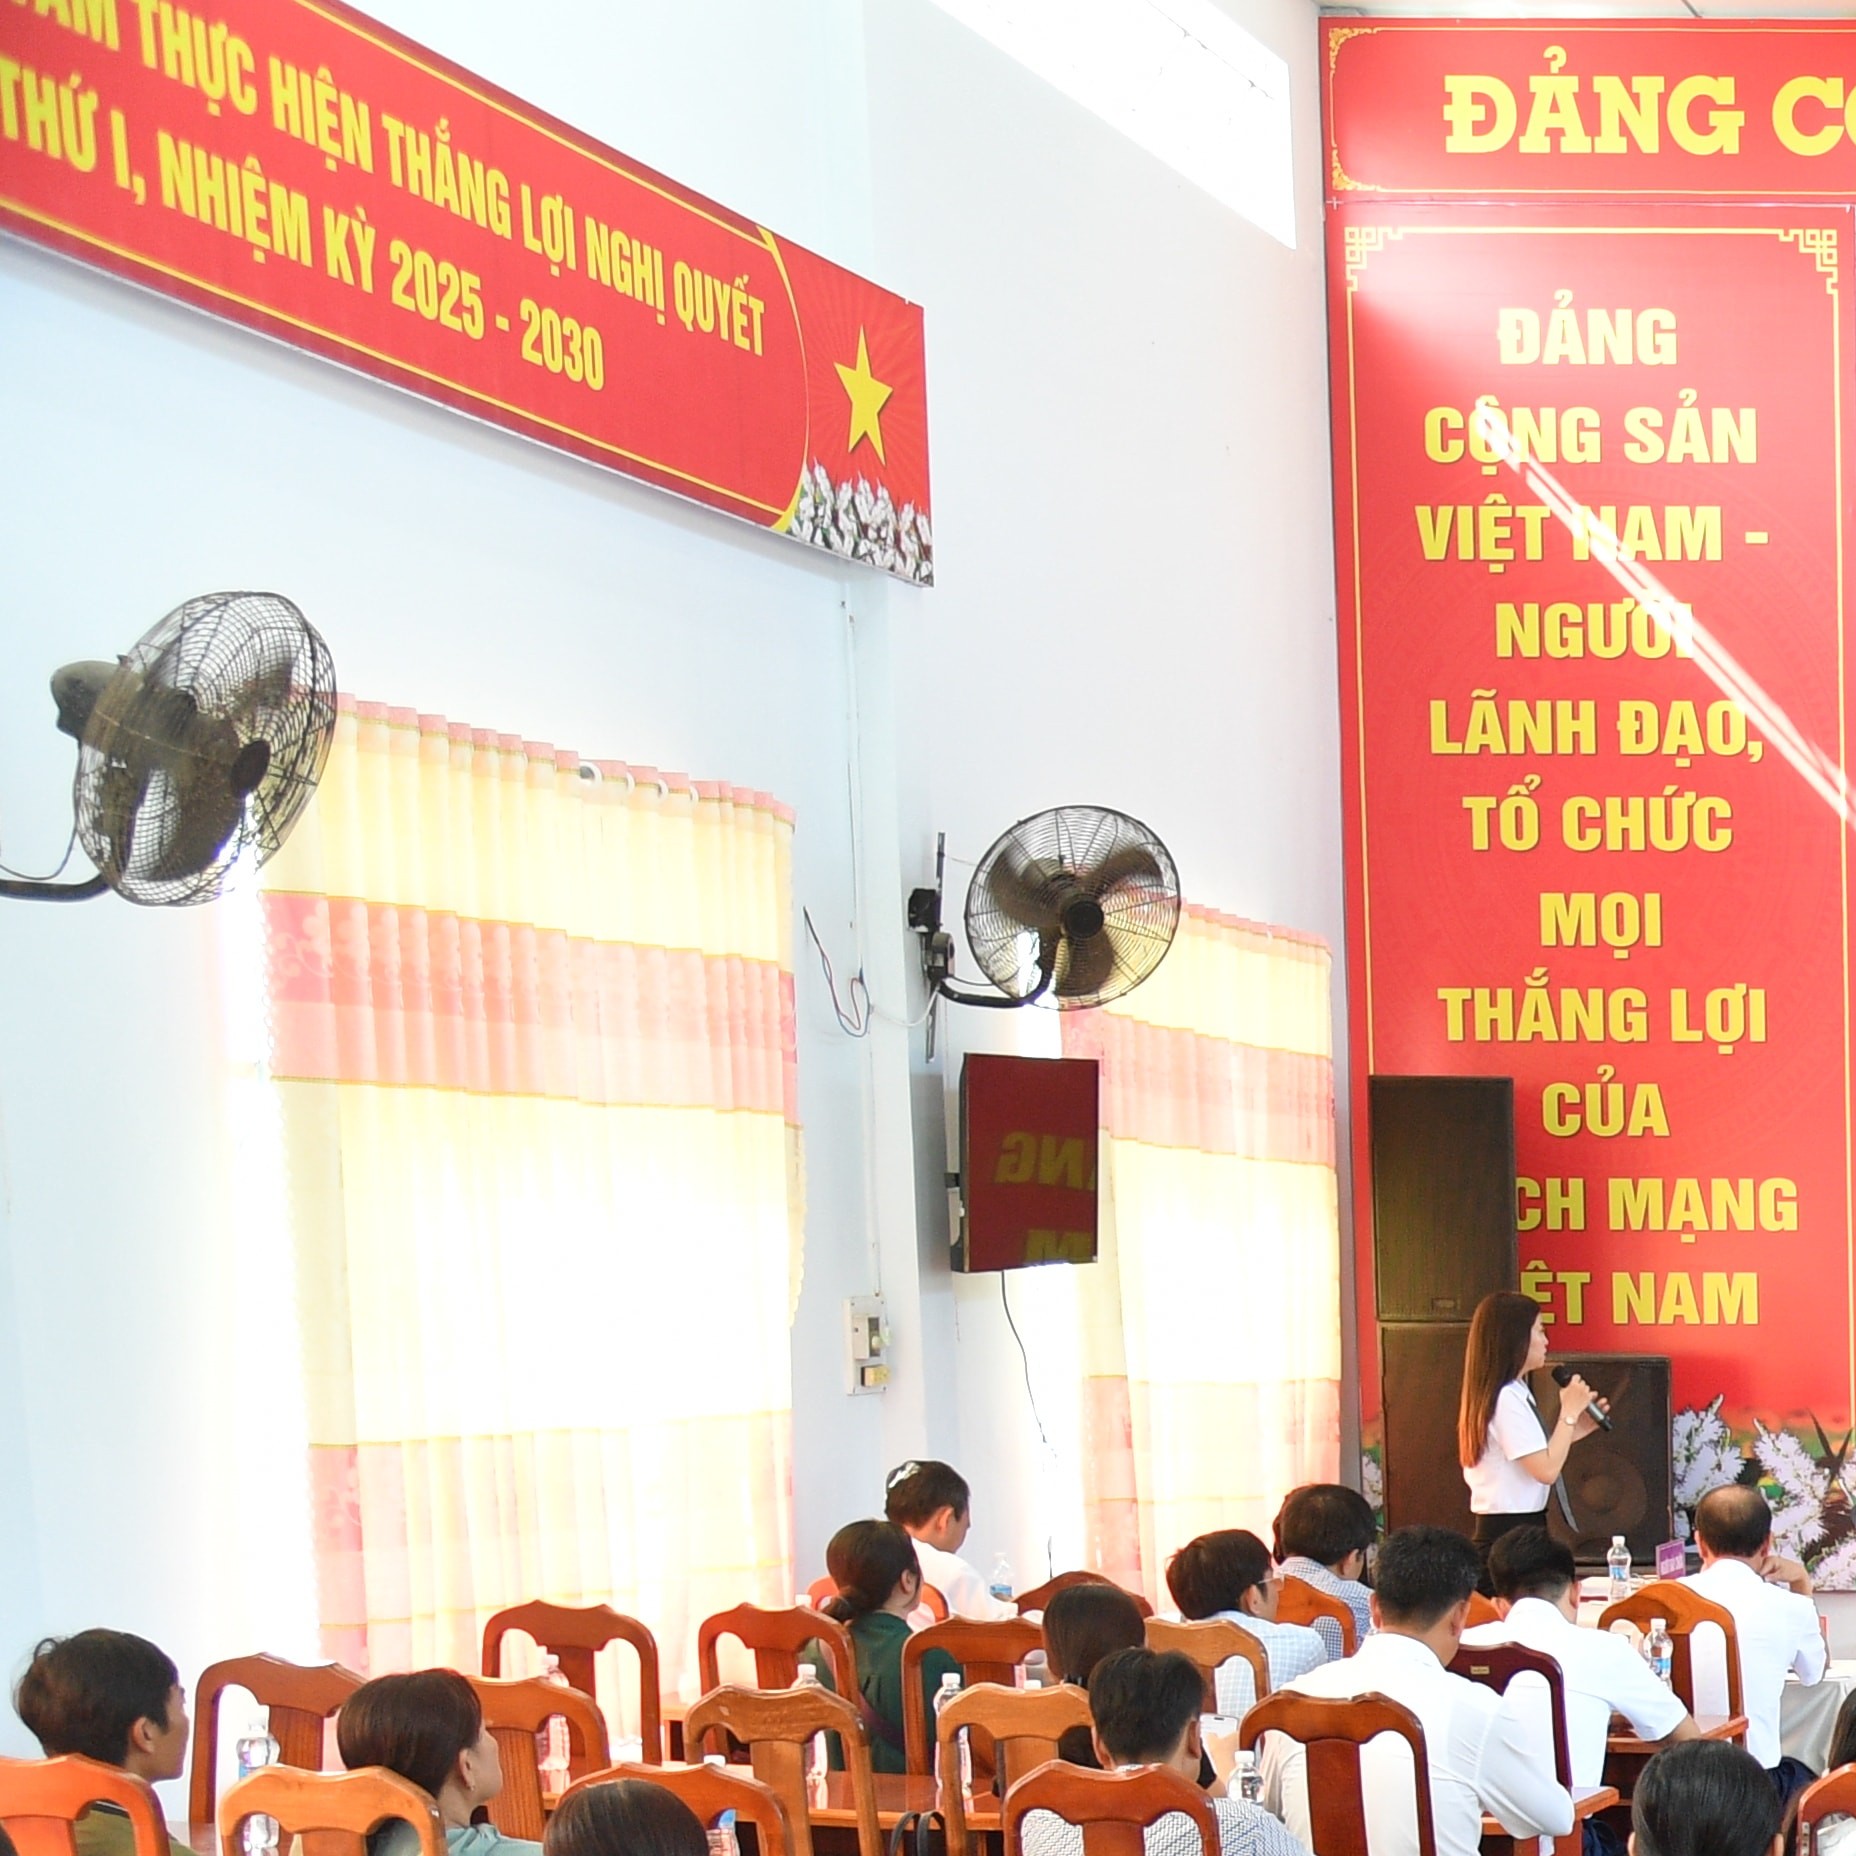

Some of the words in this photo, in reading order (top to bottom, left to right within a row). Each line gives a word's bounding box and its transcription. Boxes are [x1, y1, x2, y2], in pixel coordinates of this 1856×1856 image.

[1443, 45, 1745, 155] ĐẢNG
[132, 0, 257, 116] THỰC
[269, 67, 373, 174] HIỆN
[382, 113, 511, 238] THẮNG
[521, 184, 576, 275] LỢI
[585, 216, 665, 324] NGHỊ
[674, 261, 764, 354] QUYẾT
[0, 57, 98, 172] THỨ
[111, 110, 146, 204] I,
[157, 130, 312, 266] NHIỆM
[323, 206, 375, 293] KỲ
[390, 240, 484, 339] 2025
[520, 298, 603, 390] 2030
[1496, 289, 1677, 365] ĐẢNG
[1424, 395, 1601, 476] CỘNG
[1623, 388, 1758, 463] SẢN
[1414, 494, 1550, 573] VIỆT
[1572, 505, 1722, 562] NAM
[1428, 688, 1597, 755] LÃNH
[1616, 699, 1764, 768] ĐẠO,
[1461, 774, 1540, 851] TỔ
[1562, 780, 1733, 852] CHỨC
[1539, 891, 1661, 960] MỌI
[1438, 967, 1648, 1043] THẮNG
[1670, 982, 1767, 1055] LỢI
[1542, 1064, 1671, 1137] CỦA
[1607, 1177, 1798, 1243] MẠNG
[1611, 1272, 1759, 1326] NAM
